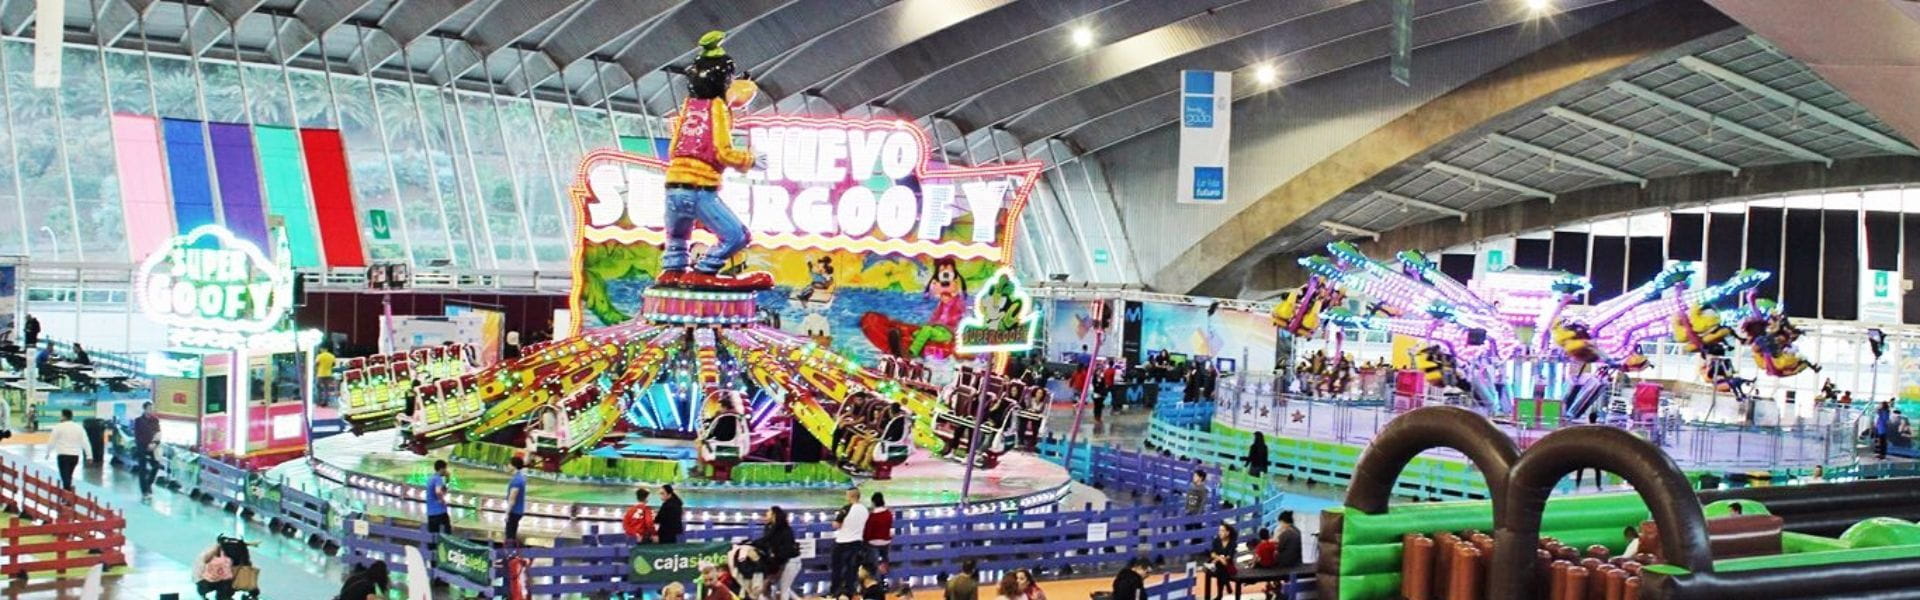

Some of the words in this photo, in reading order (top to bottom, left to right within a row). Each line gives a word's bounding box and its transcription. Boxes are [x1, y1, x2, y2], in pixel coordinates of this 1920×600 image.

[748, 127, 918, 184] NUEVO
[589, 164, 1011, 244] SUERGOOFY
[170, 249, 248, 283] SUPER
[148, 273, 274, 321] GOOFY
